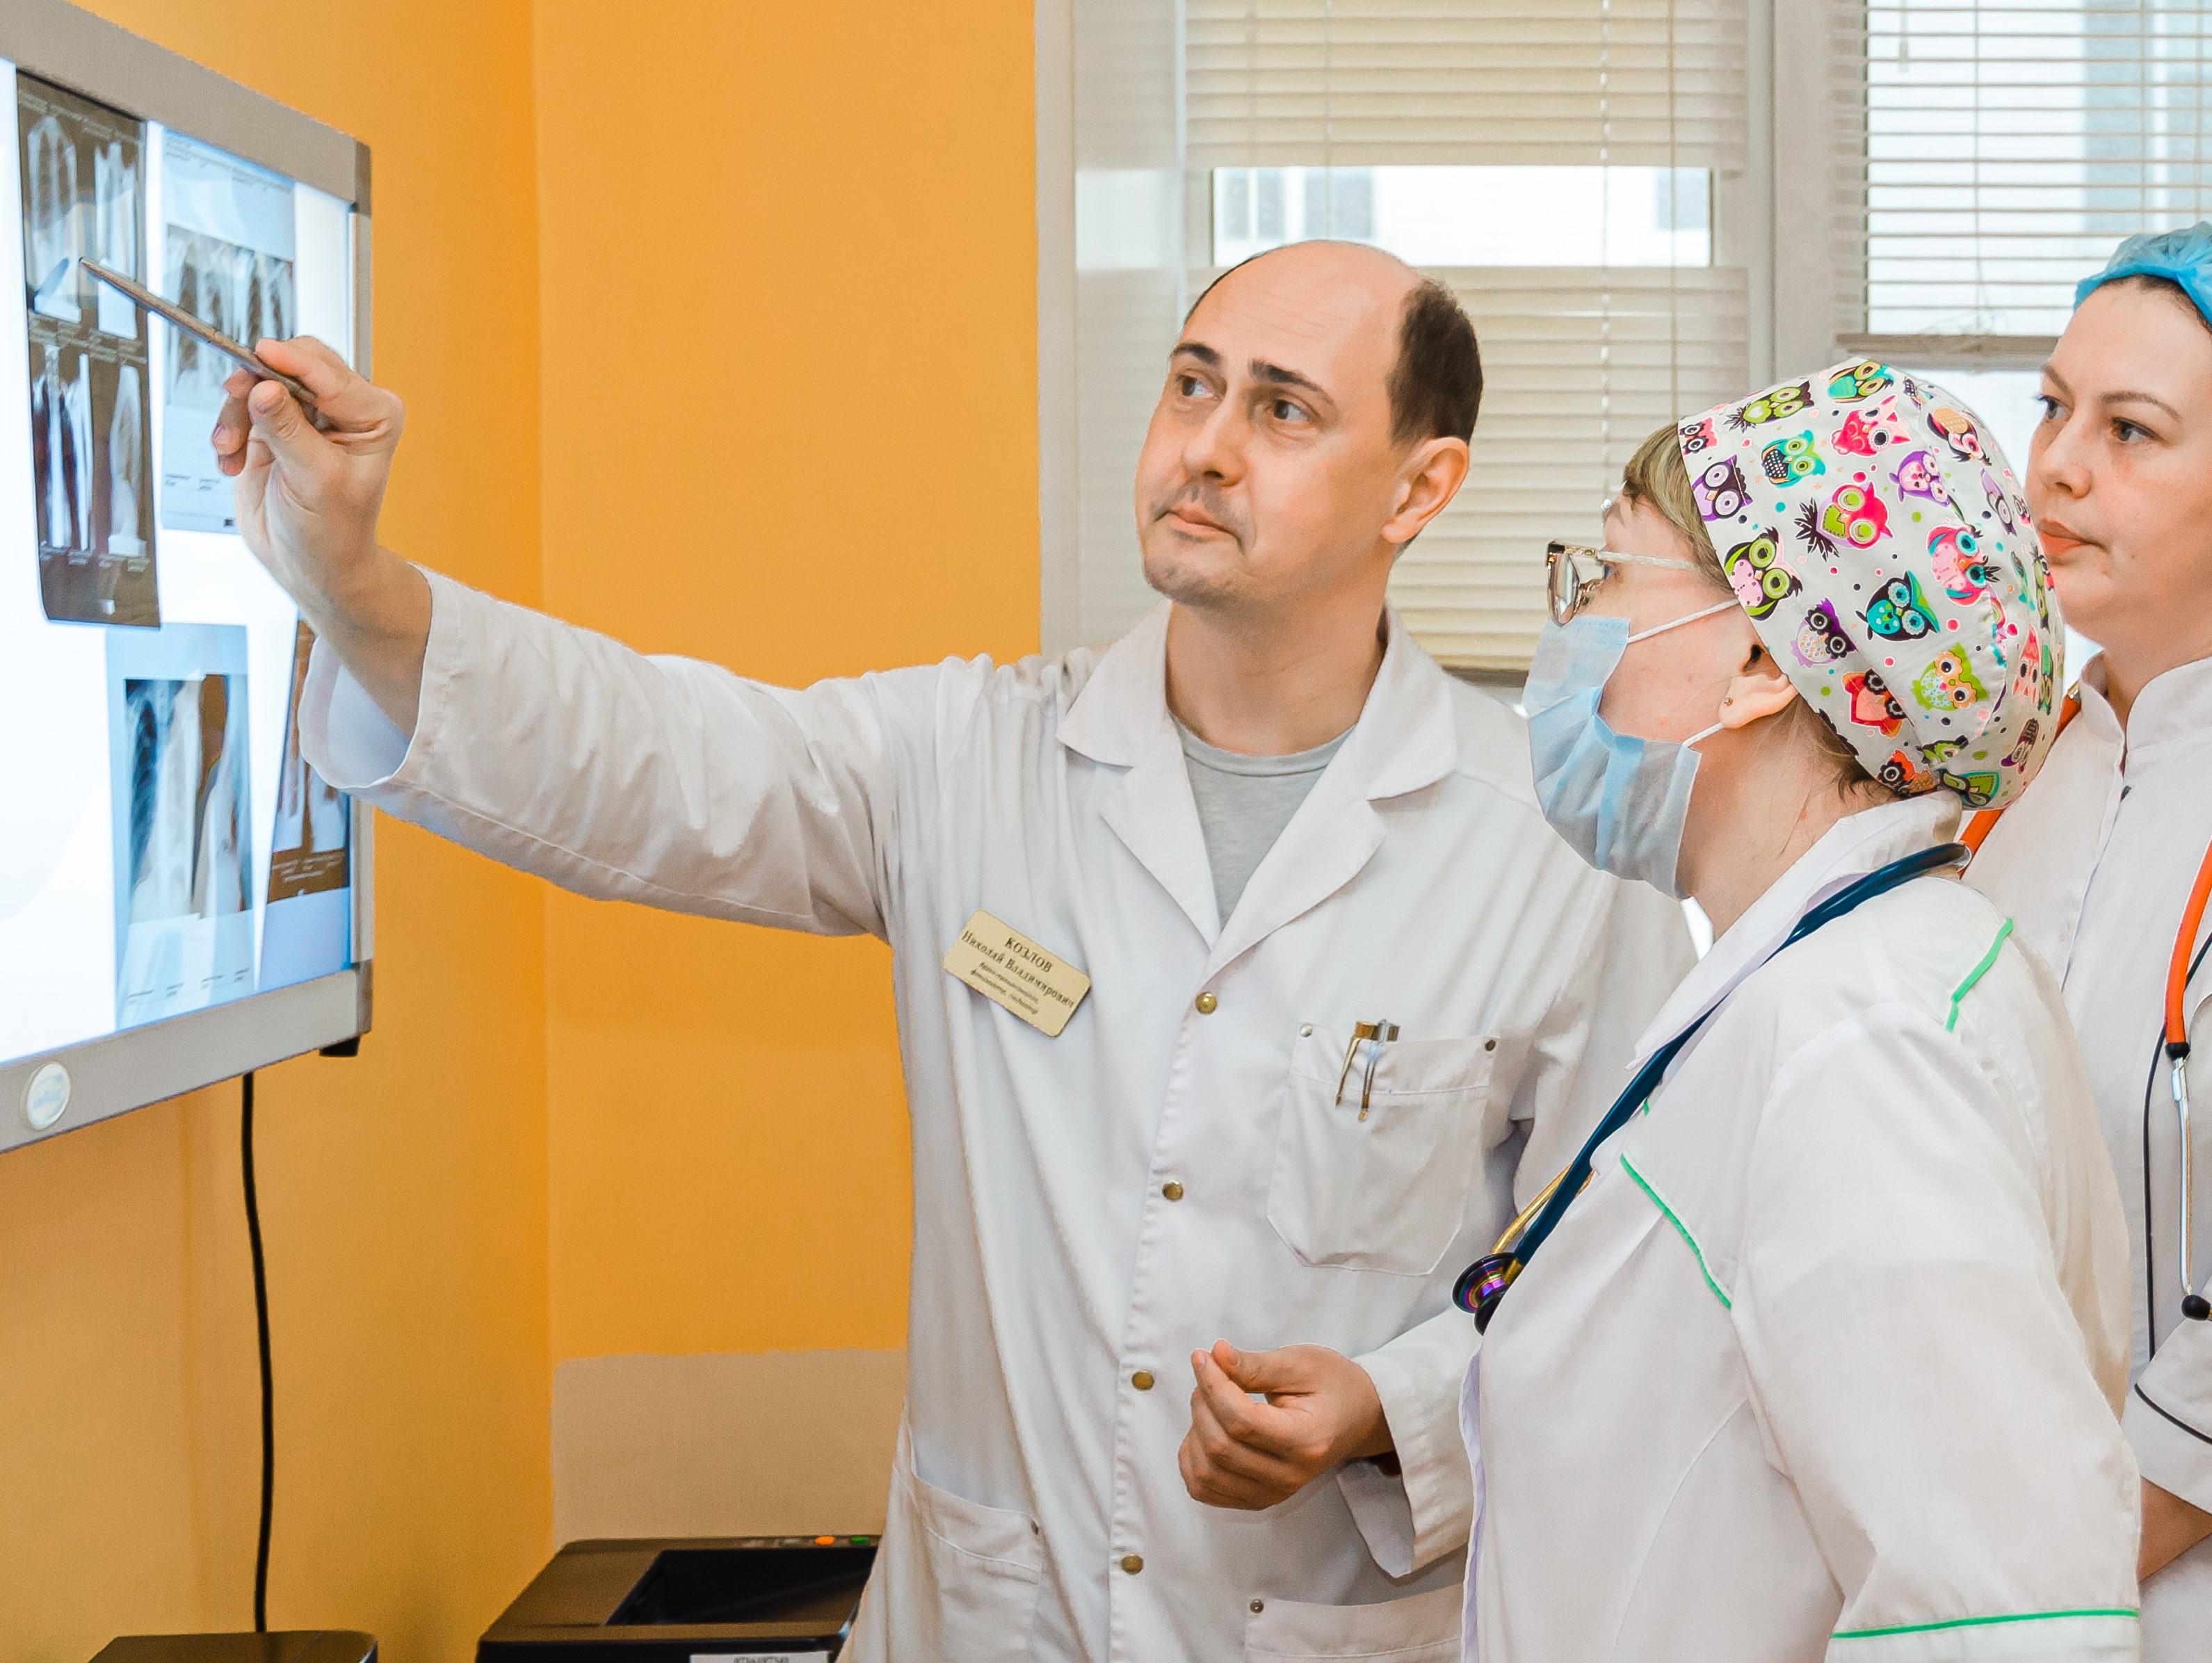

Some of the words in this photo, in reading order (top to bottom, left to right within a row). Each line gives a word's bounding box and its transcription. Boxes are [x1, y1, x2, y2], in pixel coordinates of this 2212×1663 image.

[961, 930, 1005, 964] Николай
[1005, 958, 1075, 1008] Владимирович
[1004, 936, 1053, 973] КОЗЛОВ
